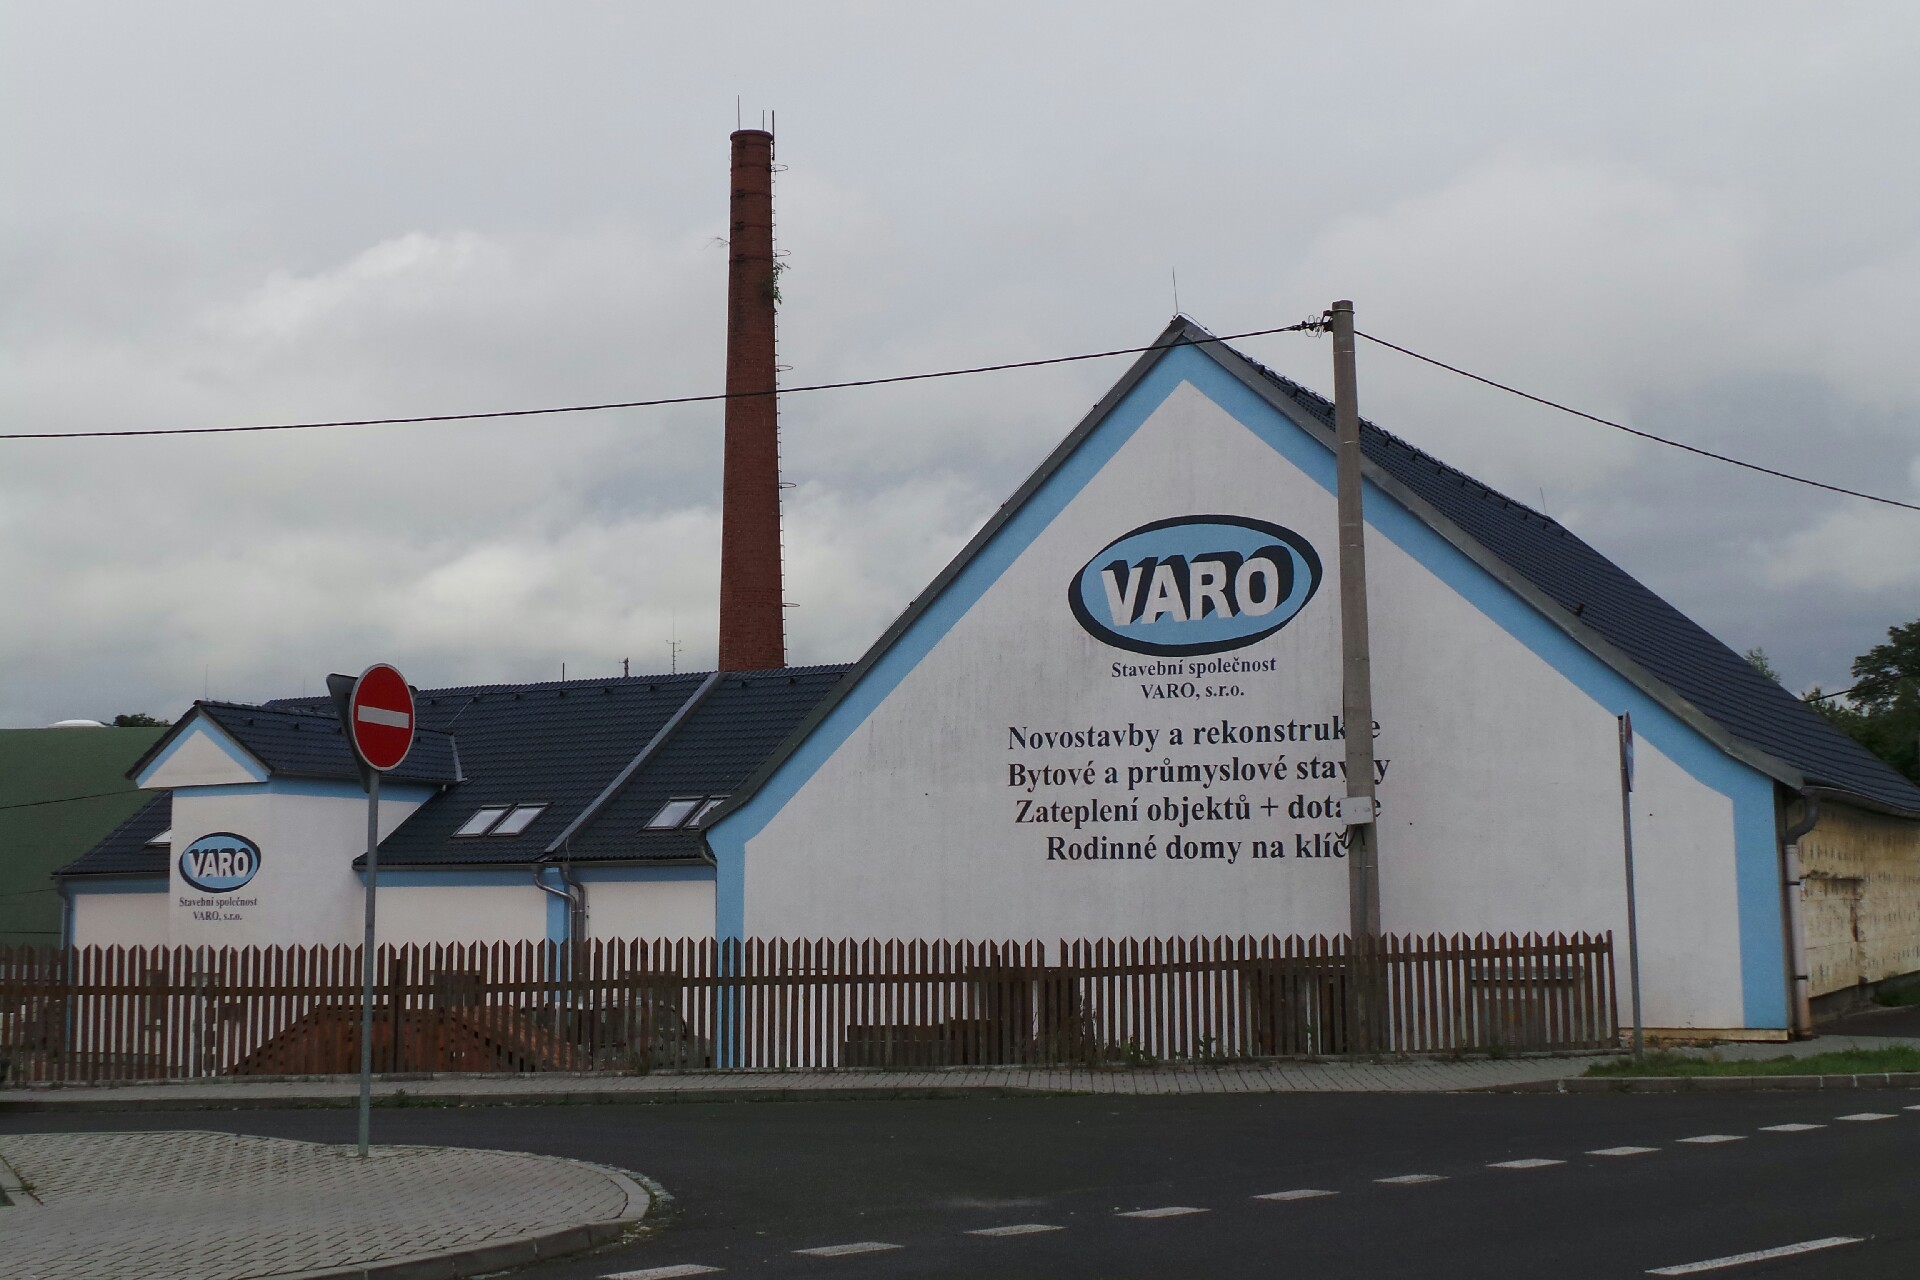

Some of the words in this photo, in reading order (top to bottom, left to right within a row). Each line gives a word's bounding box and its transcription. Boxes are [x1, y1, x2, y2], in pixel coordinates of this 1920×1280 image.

[1101, 545, 1295, 627] VARO
[1111, 660, 1184, 678] Stavební
[1188, 656, 1277, 679] společnost
[1141, 682, 1200, 700] VARO,
[1205, 684, 1245, 698] s.r.o.
[1008, 723, 1160, 752] Novostavby
[1169, 727, 1183, 746] a
[1193, 715, 1381, 745] rekonstruke
[1008, 760, 1096, 792] Bytové
[1104, 766, 1118, 785] a
[1128, 754, 1288, 791] průmyslové
[1296, 755, 1391, 785] stavy
[1015, 797, 1139, 829] Zateplení
[1147, 794, 1251, 828] objektů
[1260, 796, 1279, 817] +
[188, 848, 254, 878] VARO
[1046, 835, 1157, 861] Rodinné
[1165, 834, 1242, 865] domy
[1251, 839, 1286, 859] na
[1295, 831, 1348, 859] klíč
[179, 897, 214, 907] Stavební
[216, 897, 258, 909] společnost
[223, 913, 242, 921] s.r.o.
